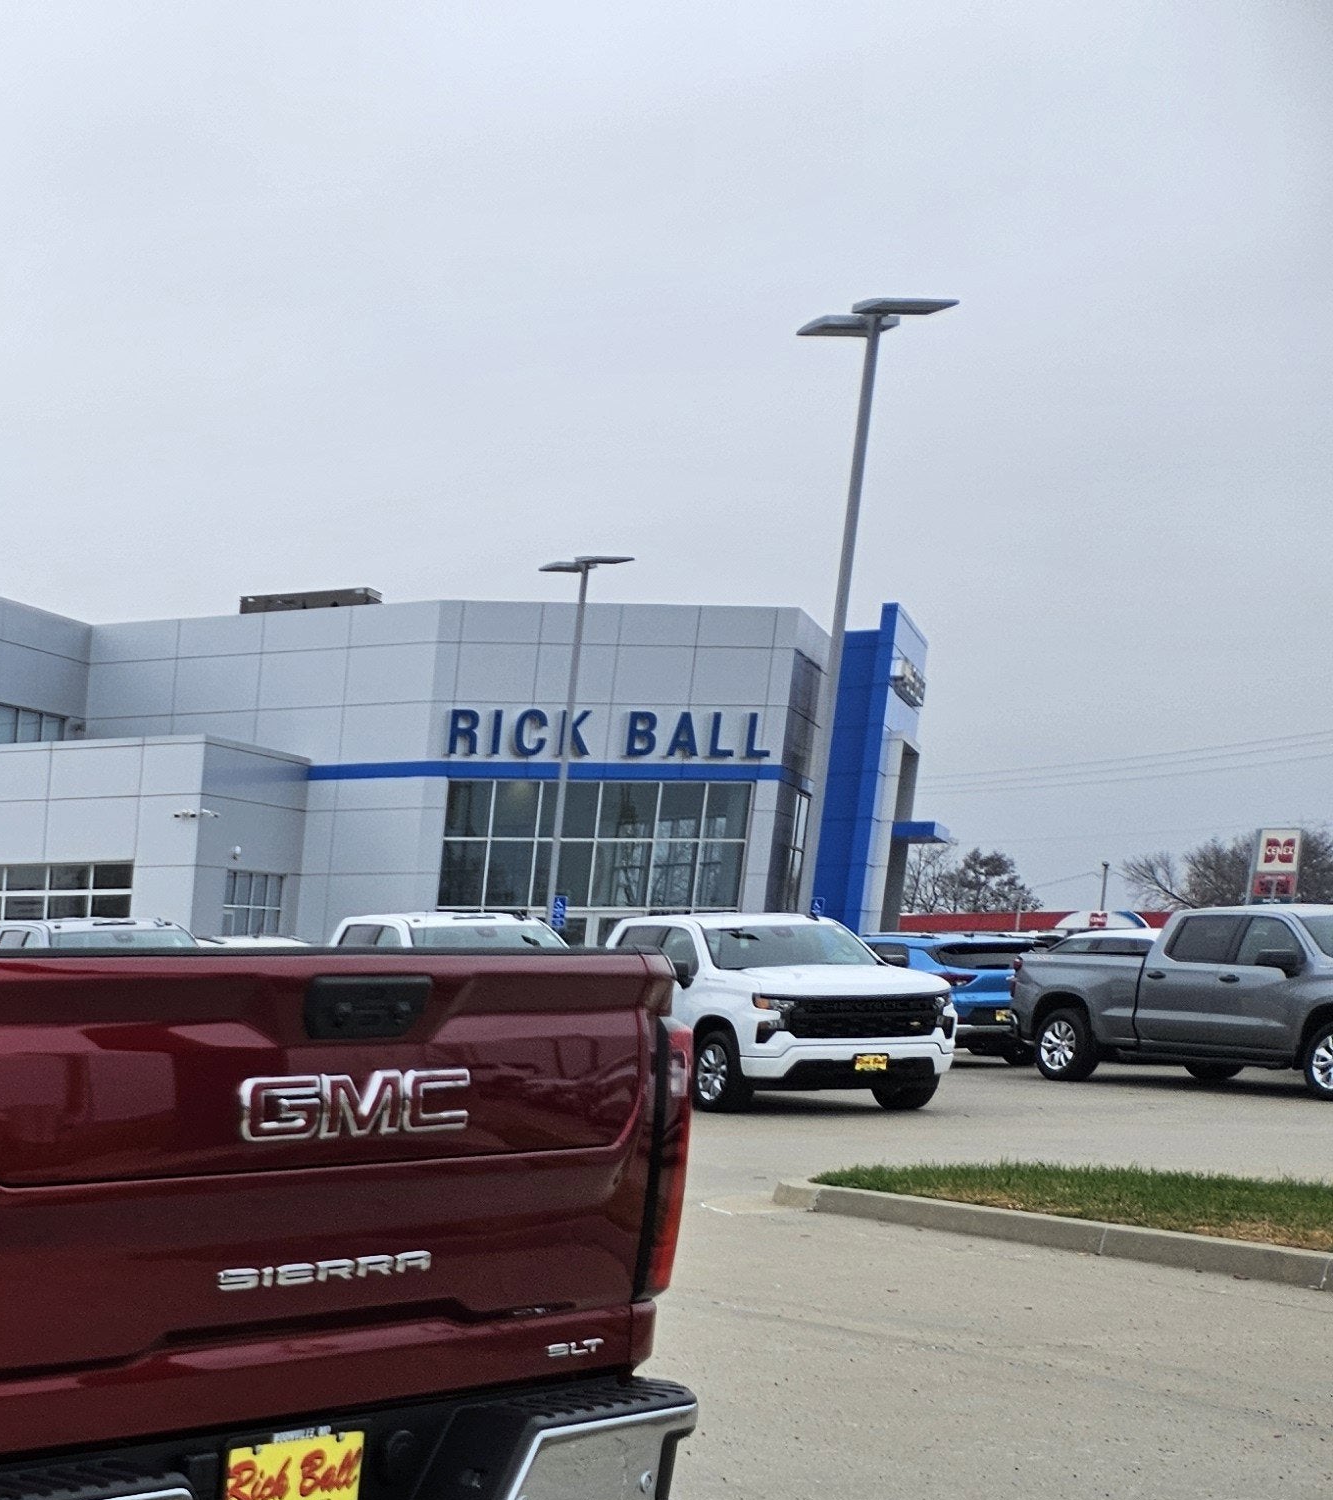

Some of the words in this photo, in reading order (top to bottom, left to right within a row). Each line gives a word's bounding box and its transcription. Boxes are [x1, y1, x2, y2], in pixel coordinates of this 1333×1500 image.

[447, 708, 593, 756] RICK
[624, 710, 770, 758] BALL
[239, 1067, 471, 1142] GMC
[216, 1249, 432, 1291] SIERRA
[544, 1337, 605, 1358] SLT
[299, 1446, 363, 1497] Ball
